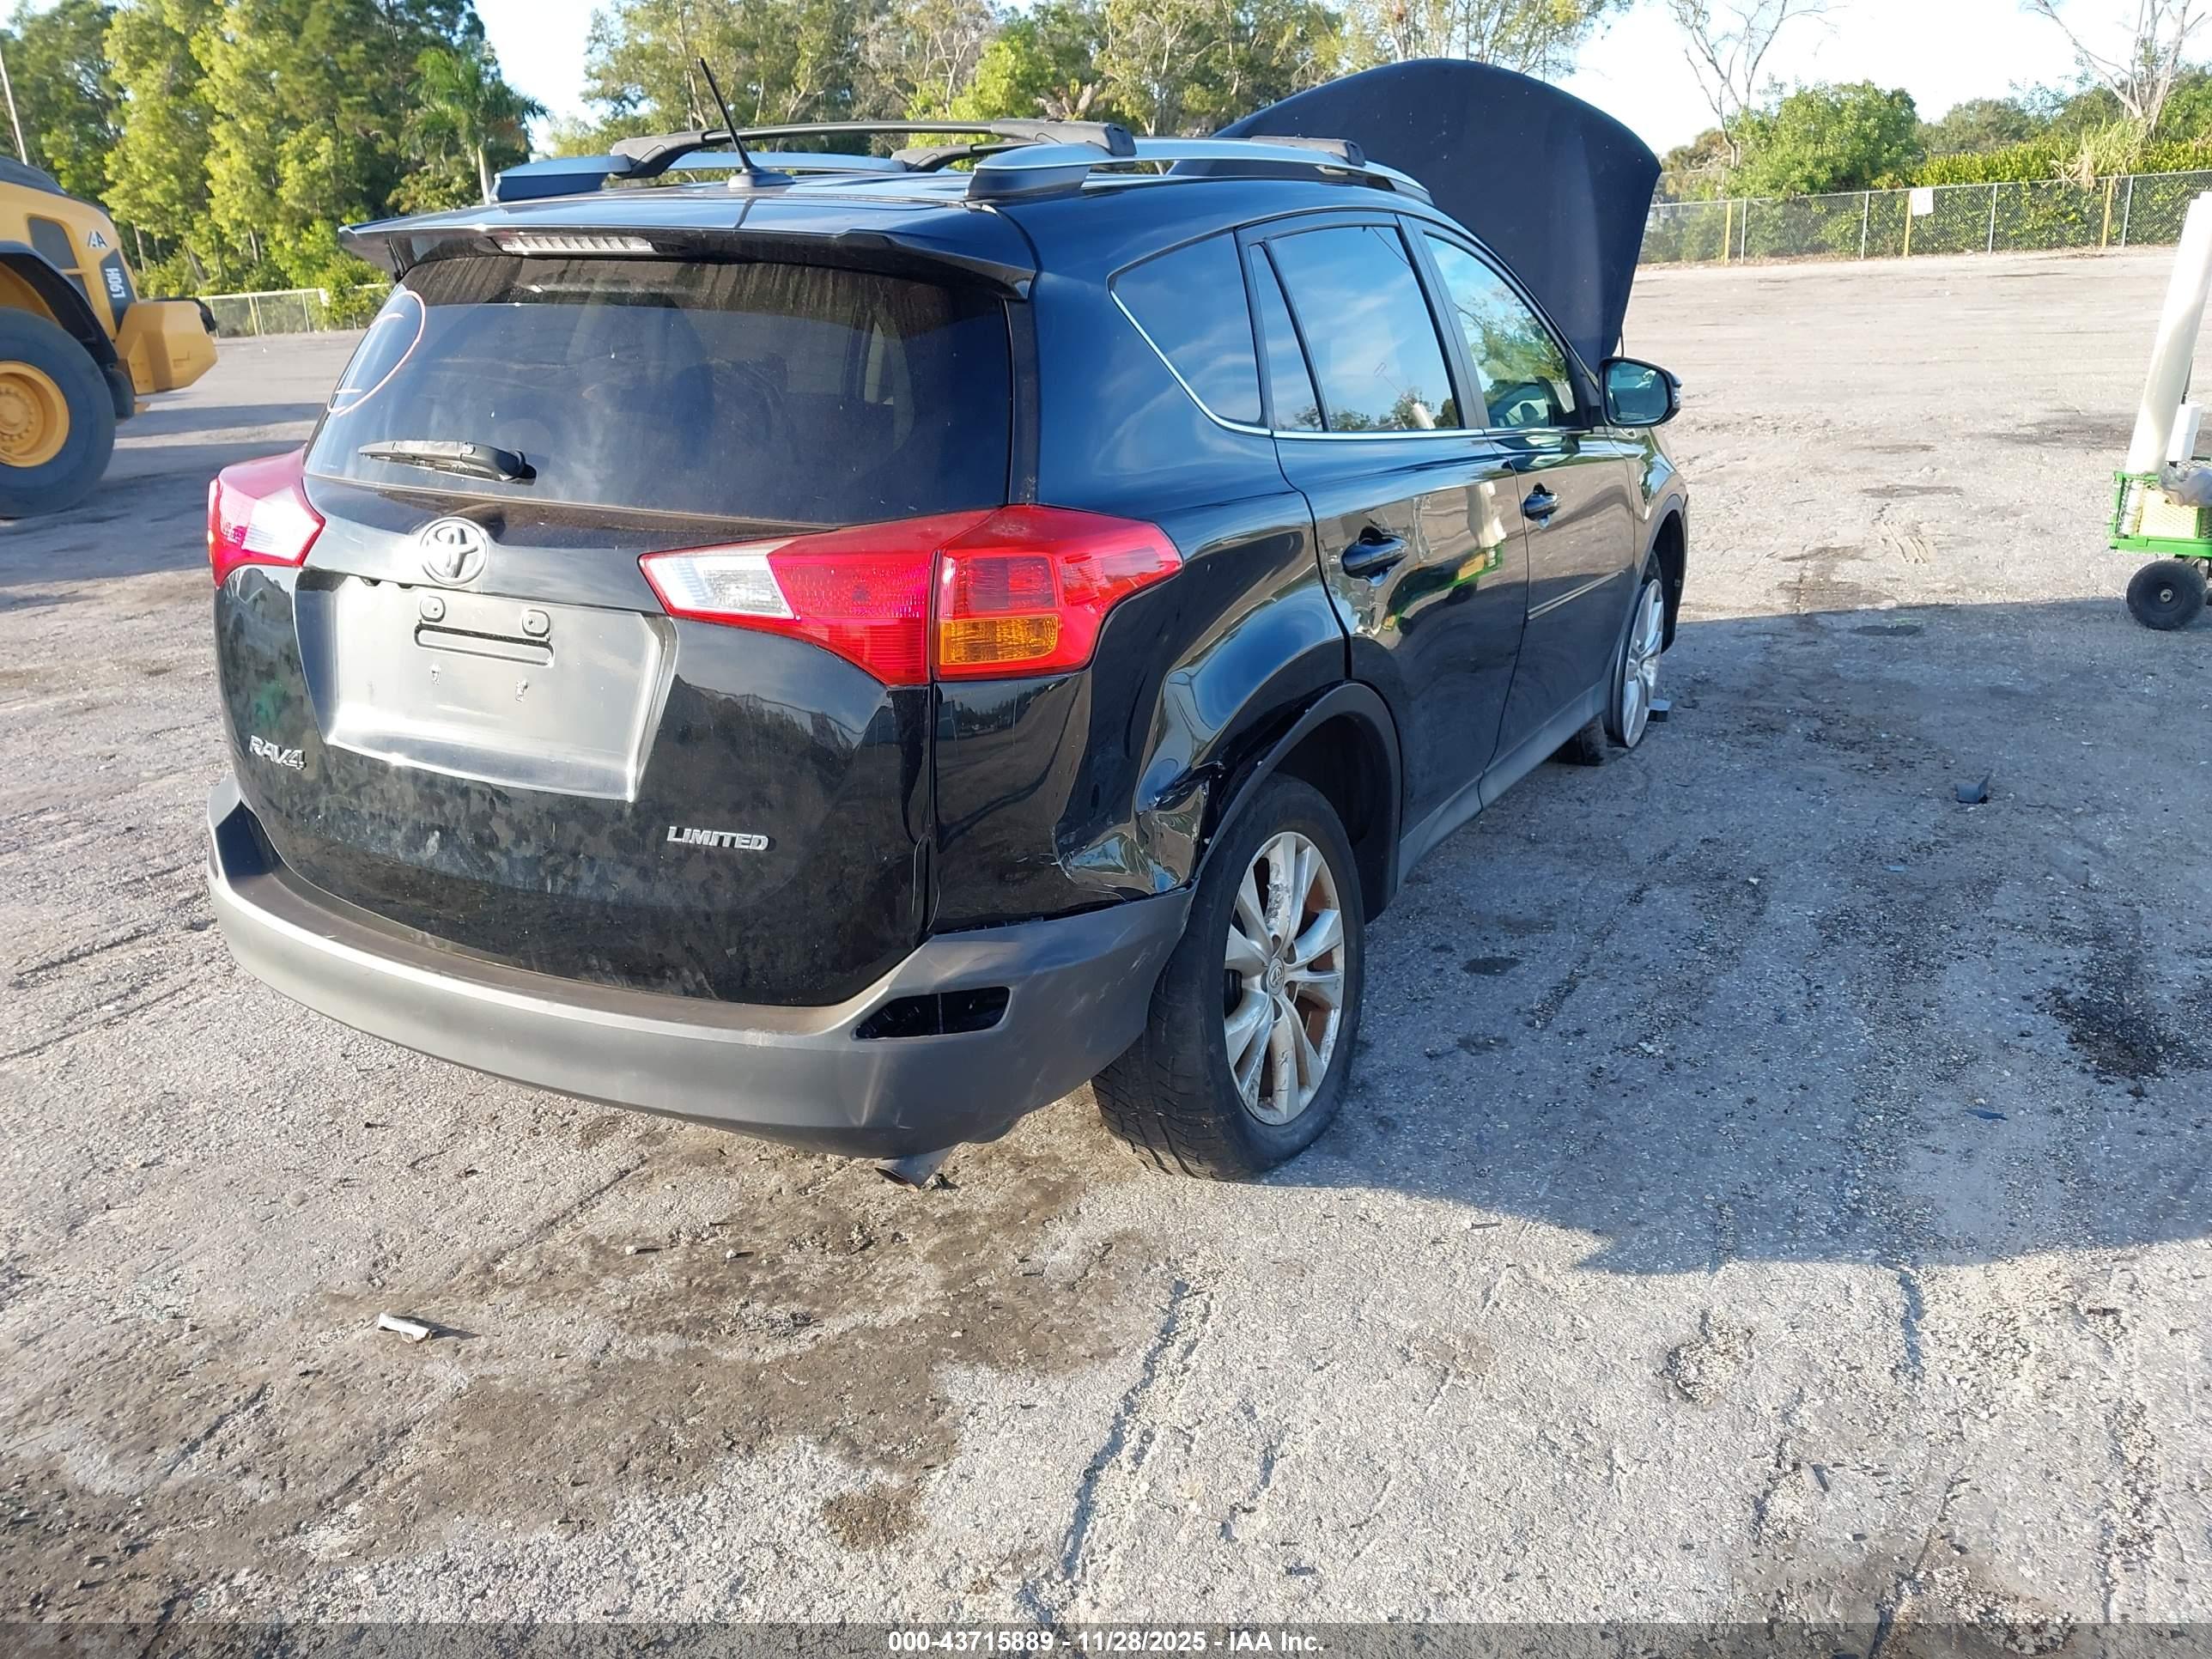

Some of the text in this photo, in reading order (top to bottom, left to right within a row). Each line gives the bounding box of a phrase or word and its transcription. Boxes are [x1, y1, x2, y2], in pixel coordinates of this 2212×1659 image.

[105, 267, 126, 298] L90H
[249, 734, 305, 770] RAV4
[666, 825, 769, 851] LIMITED
